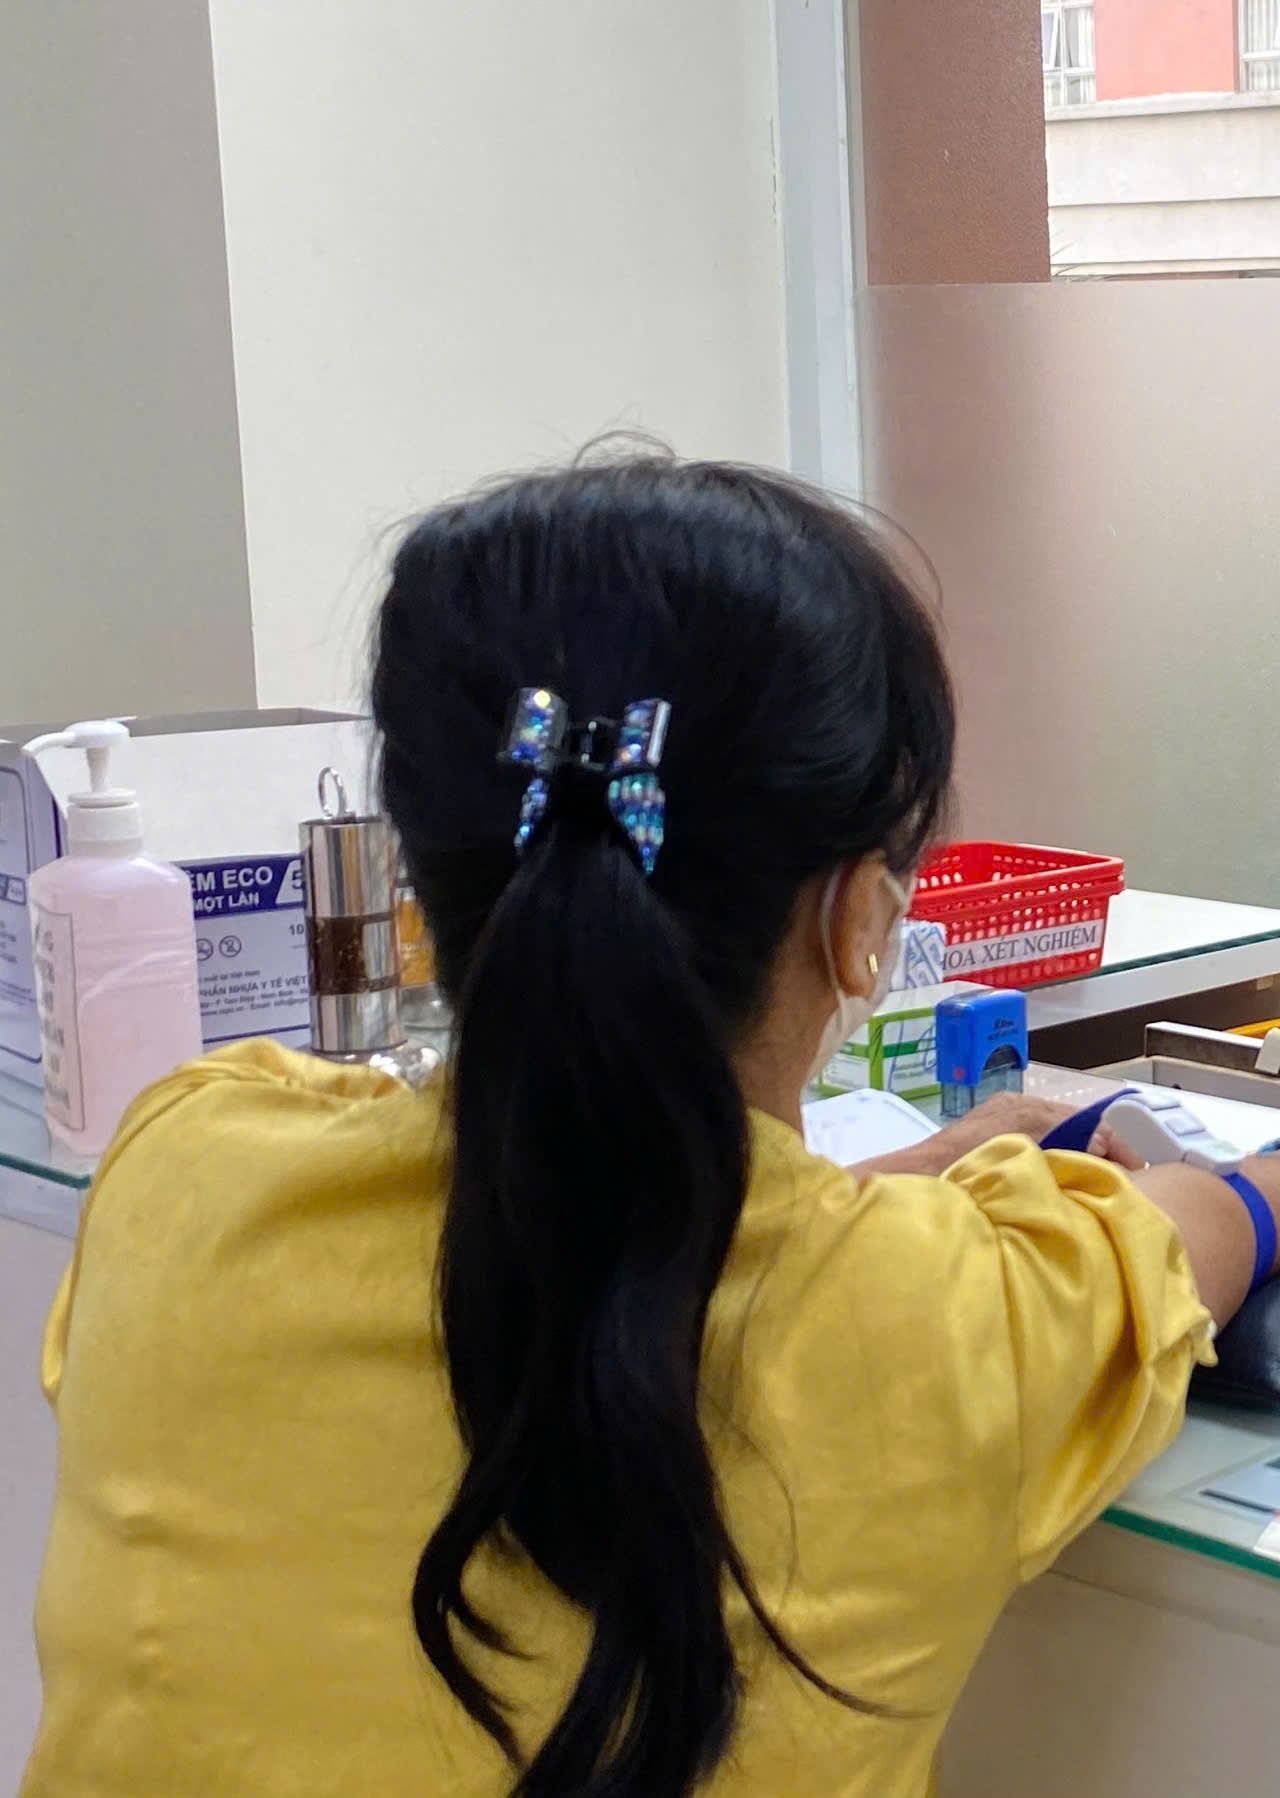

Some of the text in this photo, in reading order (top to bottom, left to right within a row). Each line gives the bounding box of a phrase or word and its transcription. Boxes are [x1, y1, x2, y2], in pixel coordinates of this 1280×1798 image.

[222, 865, 273, 890] ECO
[981, 936, 1020, 964] XÉT
[1023, 925, 1098, 954] NGHIỆM
